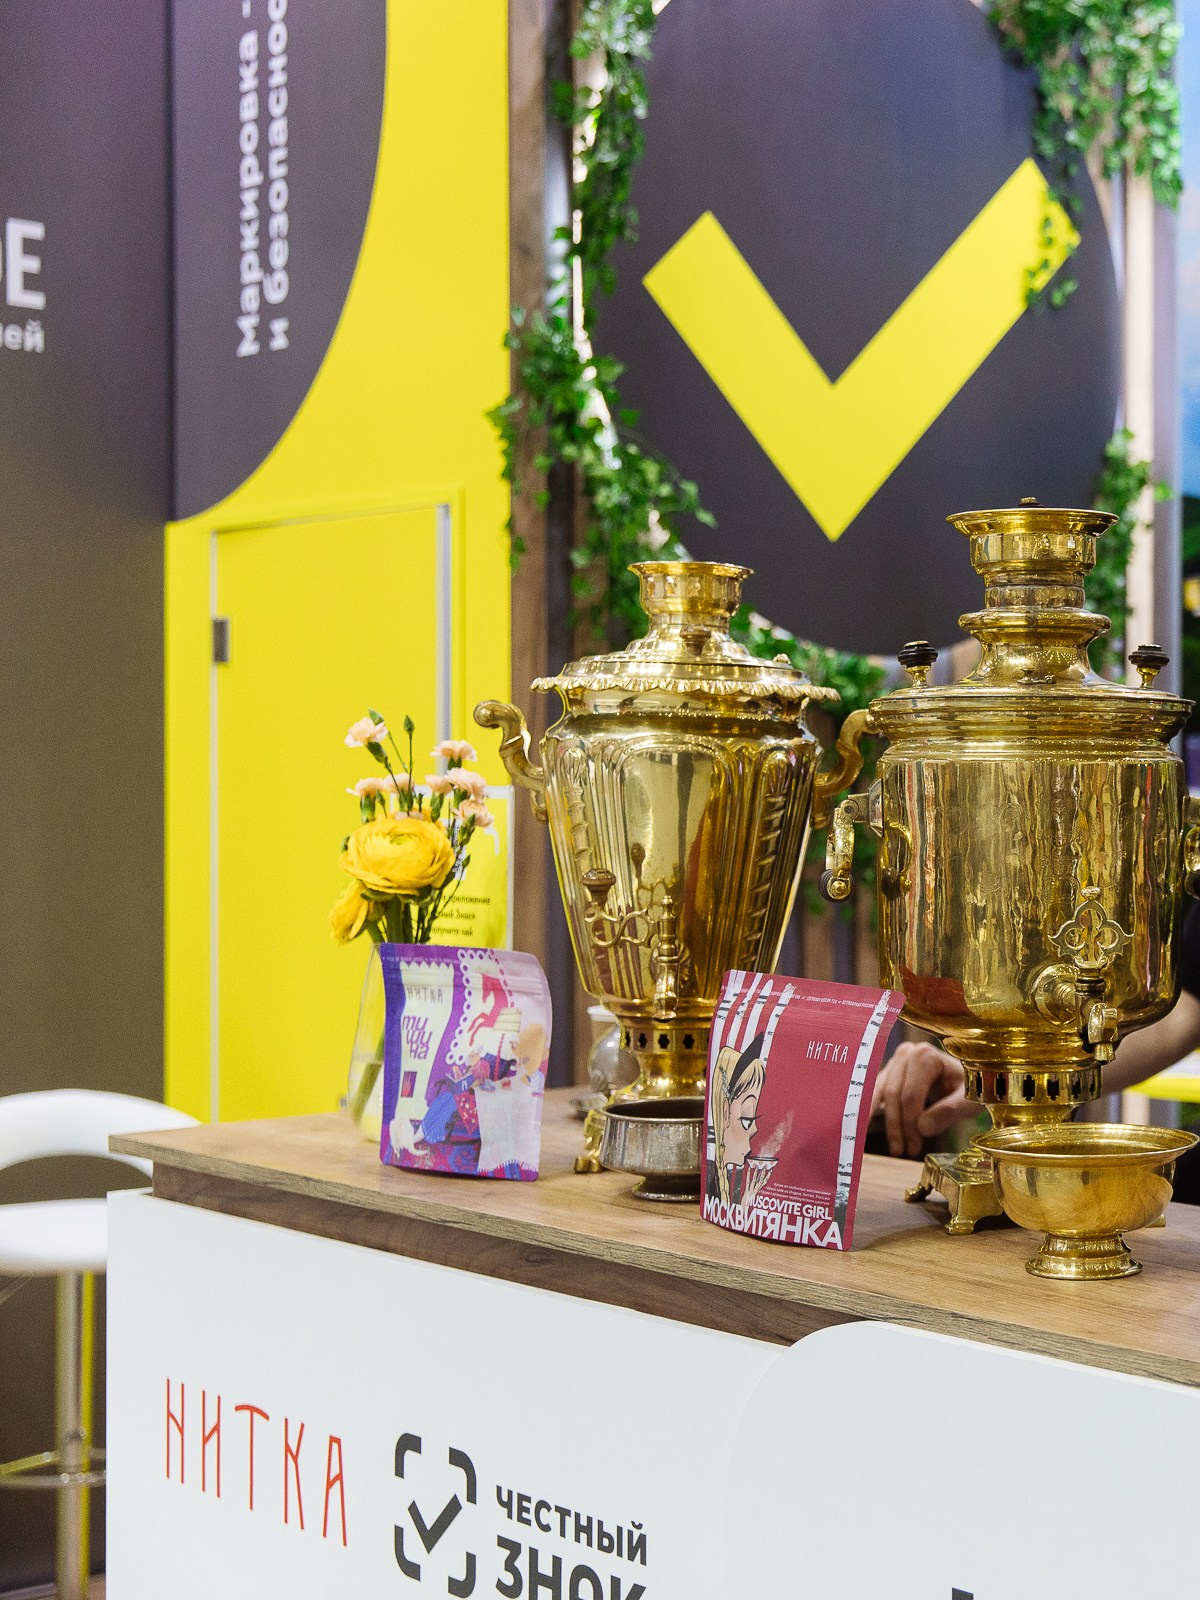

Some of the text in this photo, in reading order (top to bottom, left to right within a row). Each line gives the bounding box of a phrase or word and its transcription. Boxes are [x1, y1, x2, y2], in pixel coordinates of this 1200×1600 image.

[236, 29, 264, 357] Маркировка
[269, 317, 290, 351] и
[806, 1040, 849, 1064] НИТКА
[703, 1194, 843, 1251] МОСКВИТЯНКА
[802, 1204, 832, 1221] GIRL
[166, 1378, 348, 1546] НИТКА
[496, 1485, 647, 1566] ЧЕСТНЫЙ
